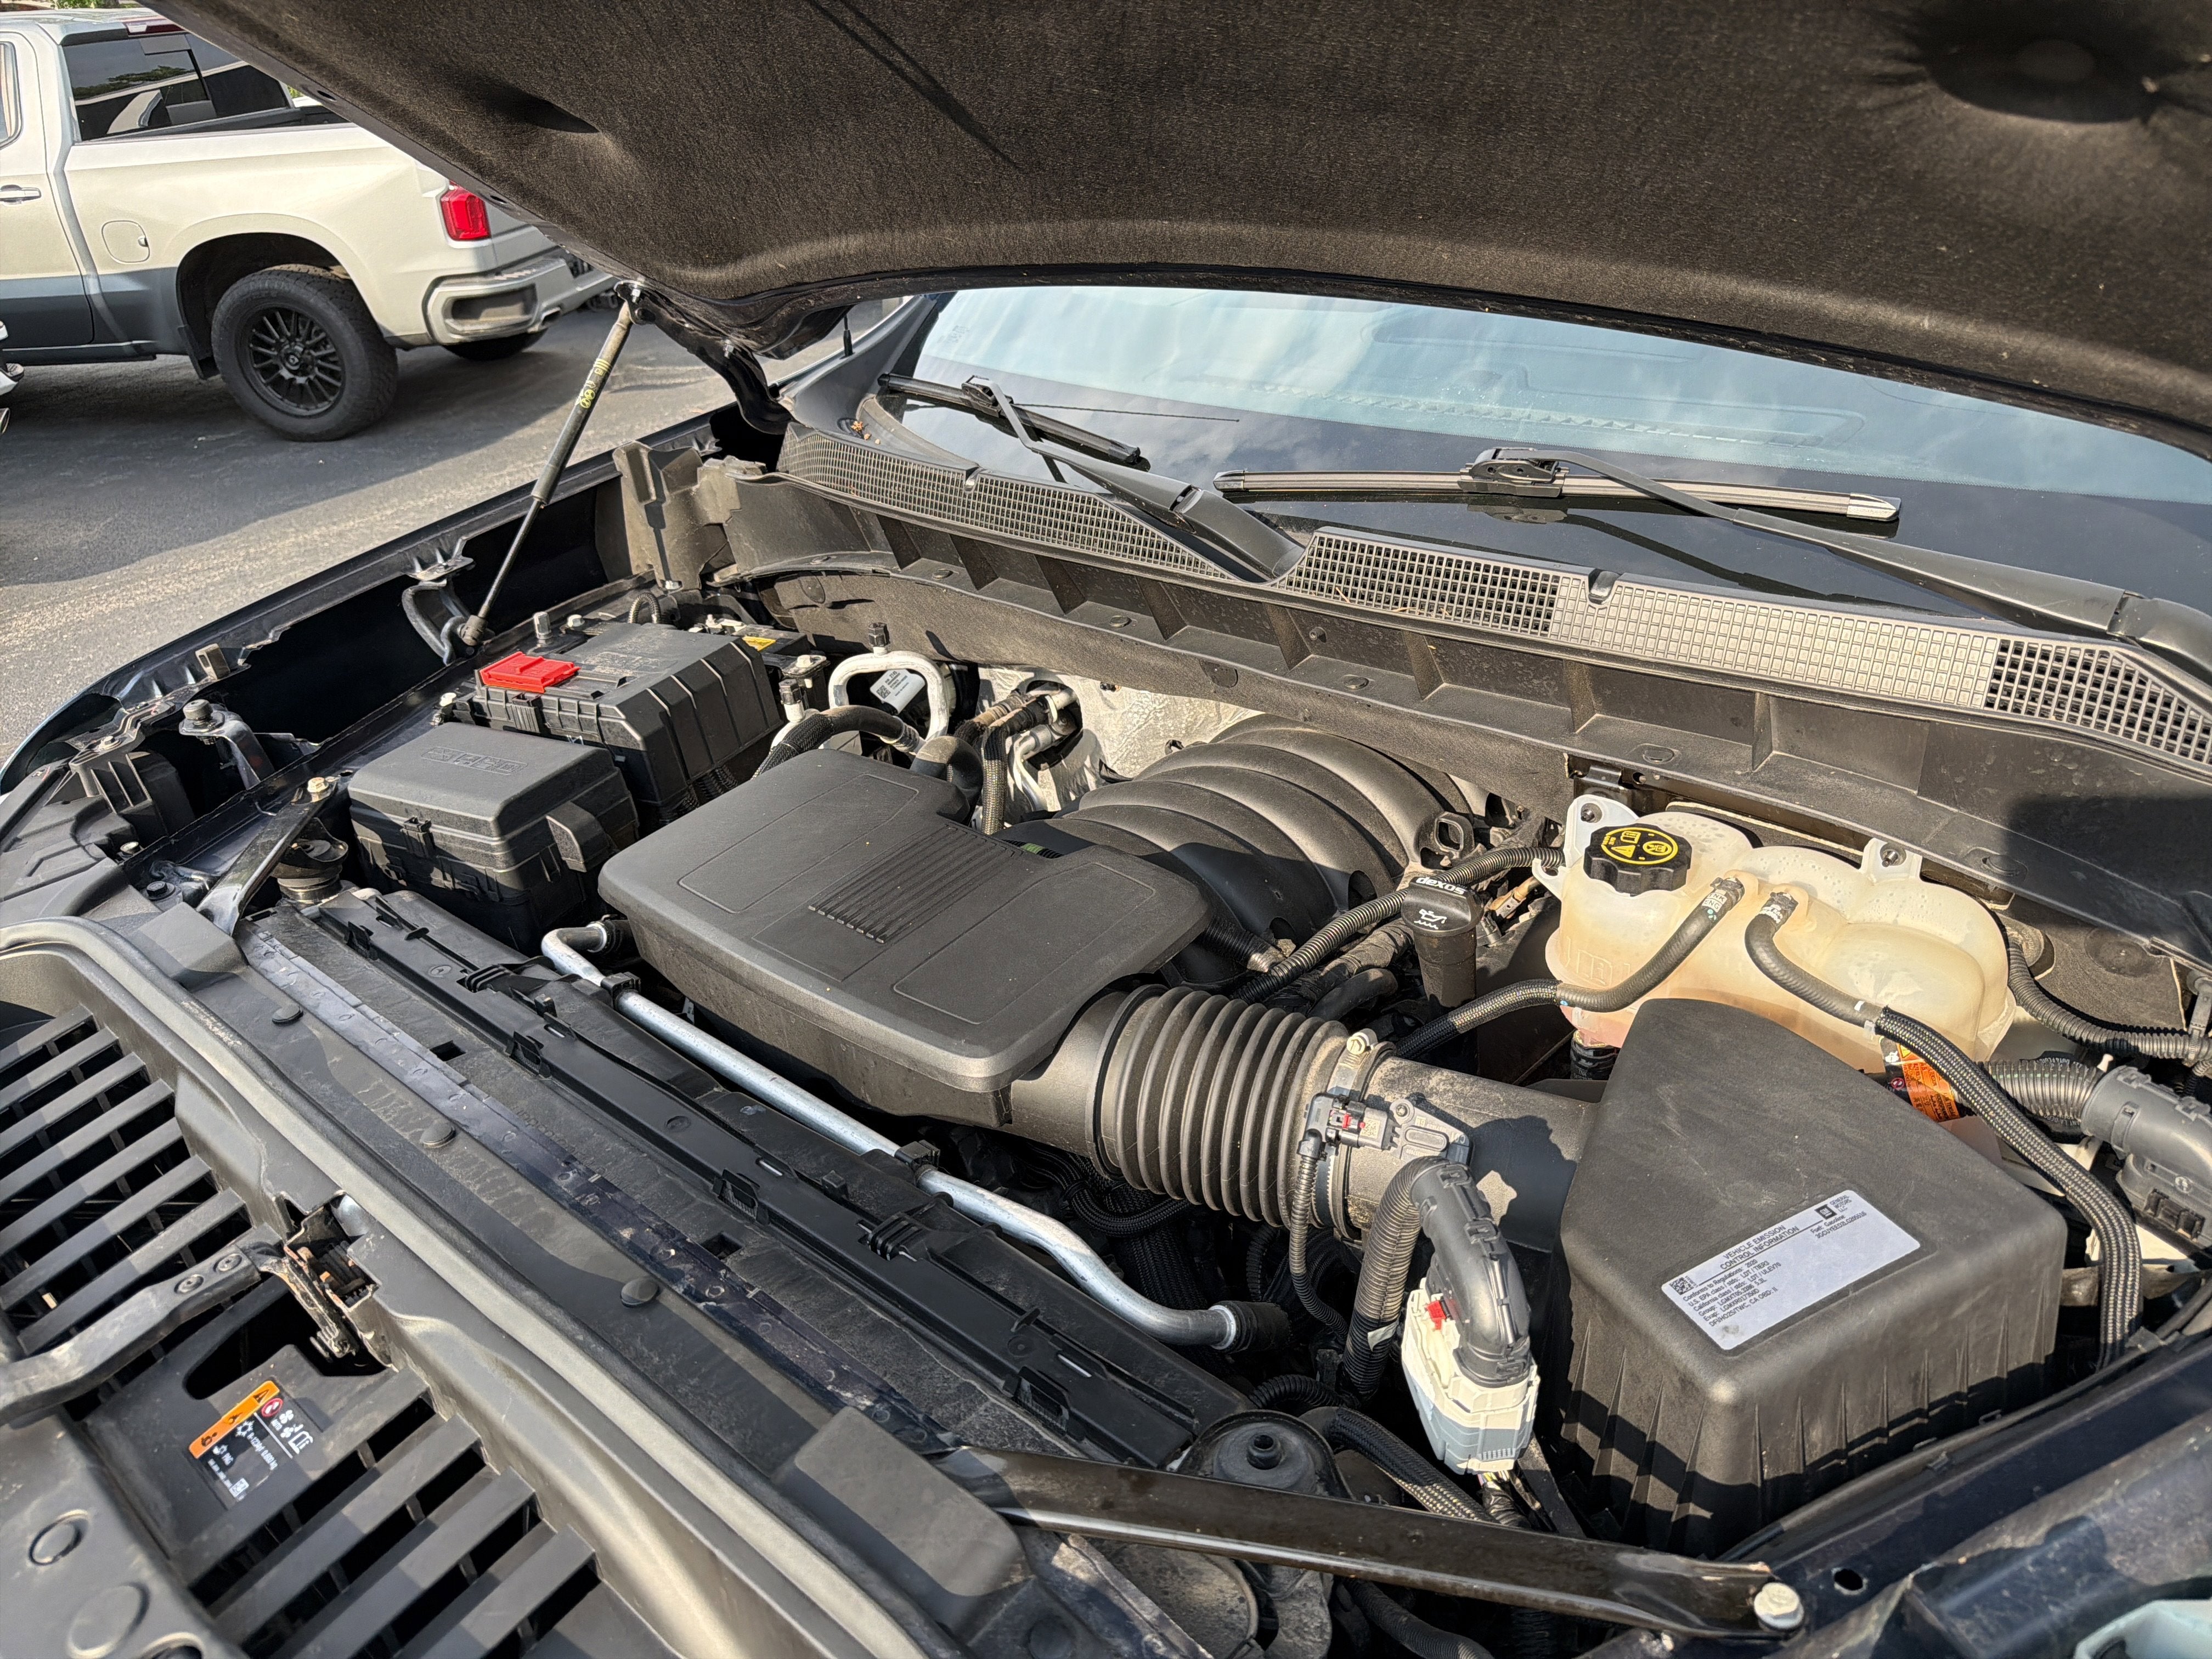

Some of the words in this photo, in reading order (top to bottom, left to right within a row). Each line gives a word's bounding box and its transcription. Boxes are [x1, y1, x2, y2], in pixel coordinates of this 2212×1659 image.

[1416, 877, 1468, 895] dexos
[1703, 899, 1720, 909] ENG
[1829, 1194, 1849, 1205] GENERAL
[1823, 1214, 1846, 1227] Gasoline
[1719, 1249, 1754, 1270] CONTROL
[1753, 1225, 1799, 1252] INFORMATION
[1723, 1241, 1753, 1260] VEHICLE
[1752, 1224, 1786, 1244] EMISSION
[1682, 1286, 1708, 1301] Conforms
[1712, 1266, 1745, 1285] Regulations:
[1745, 1259, 1758, 1268] 2020
[1688, 1298, 1701, 1306] U.S.
[1699, 1292, 1711, 1300] EPA
[1710, 1285, 1724, 1294] class
[1726, 1276, 1741, 1285] stds:
[1740, 1269, 1752, 1278] LDT
[1753, 1260, 1770, 1271] TIER3
[1693, 1295, 1719, 1311] California
[1717, 1289, 1731, 1298] class
[1733, 1280, 1747, 1289] stds:
[1747, 1273, 1760, 1282] LDT
[1698, 1304, 1718, 1317] Group:
[1754, 1277, 1767, 1285] 5.3L
[1758, 1289, 1774, 1299] OBD:
[1703, 1310, 1719, 1321] Evap:
[222, 1452, 233, 1466] PAG
[269, 1460, 278, 1470] kg
